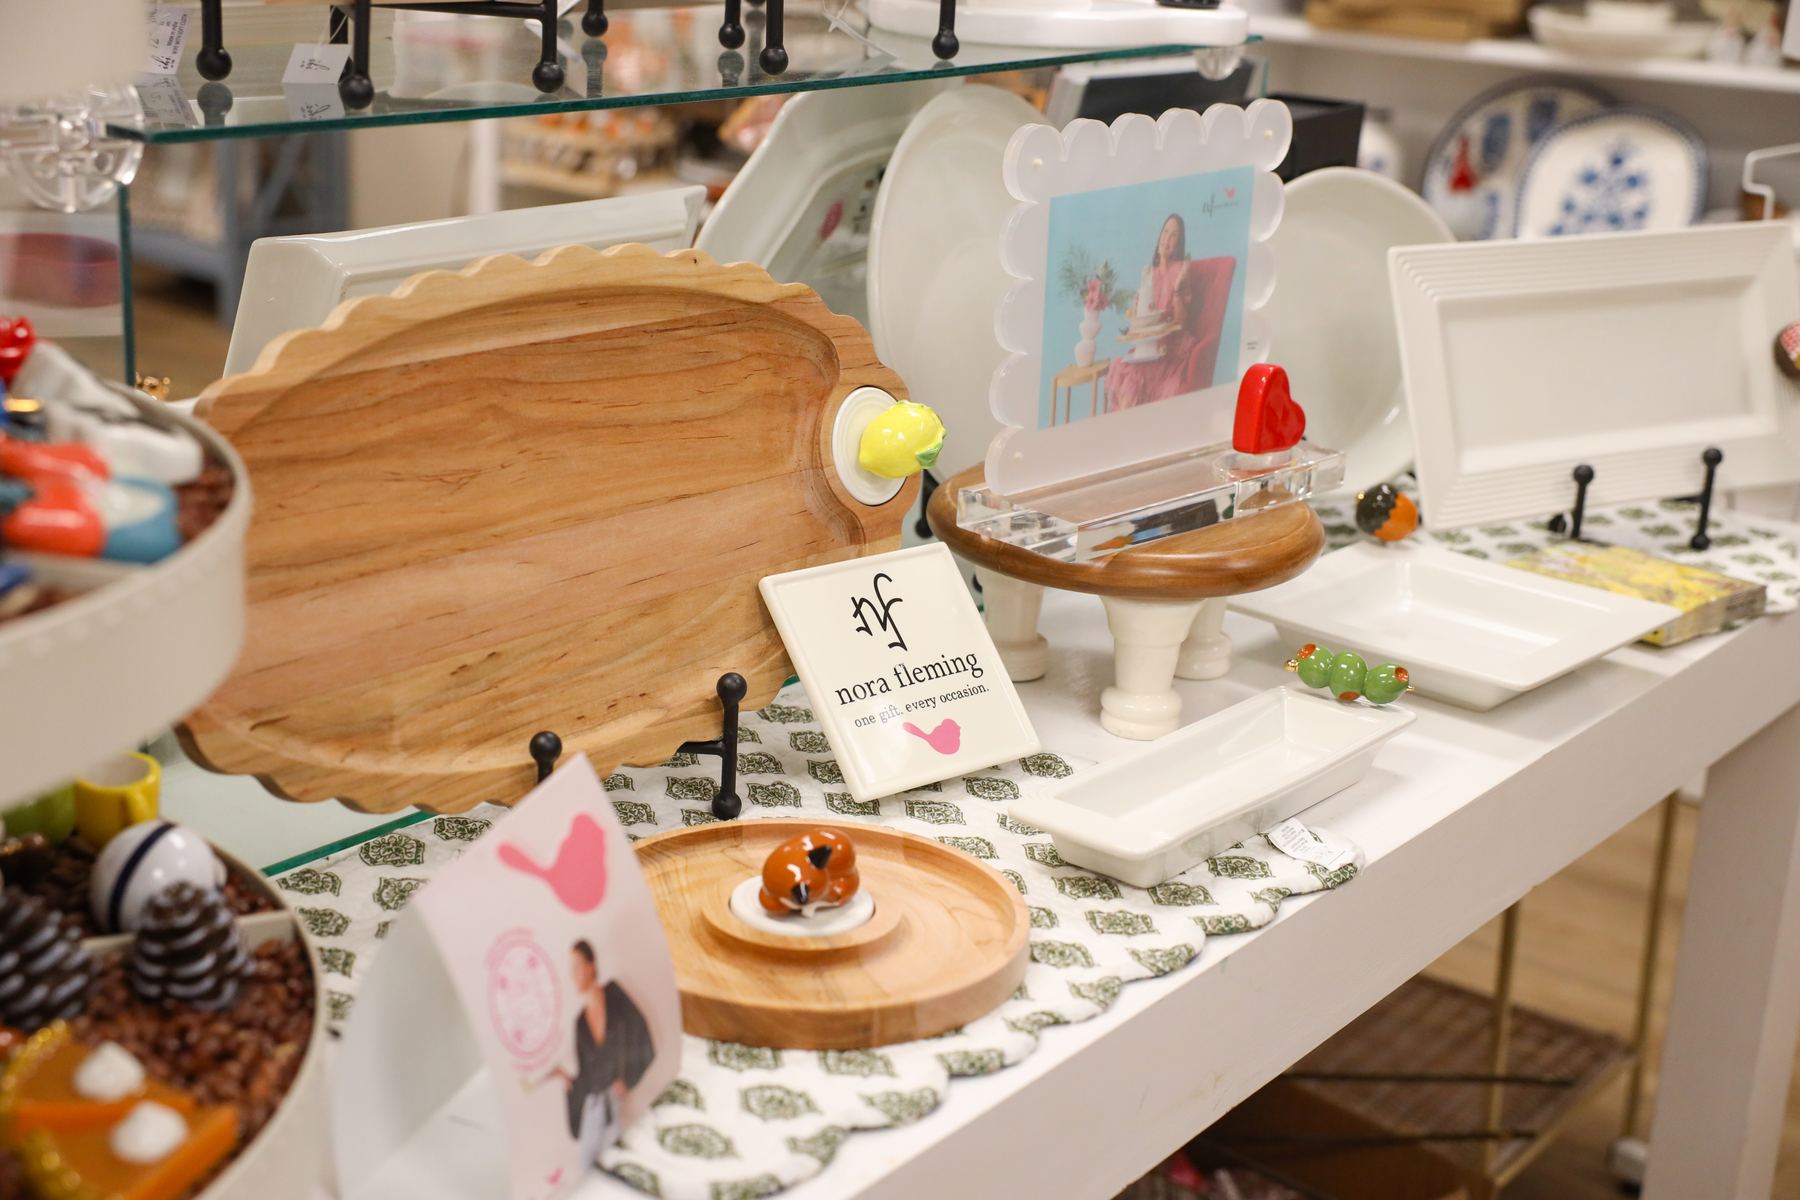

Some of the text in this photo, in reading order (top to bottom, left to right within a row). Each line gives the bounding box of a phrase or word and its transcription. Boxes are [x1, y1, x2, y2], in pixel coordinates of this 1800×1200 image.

[834, 653, 984, 705] nora fleming
[854, 684, 990, 728] one gift. every occasion.
